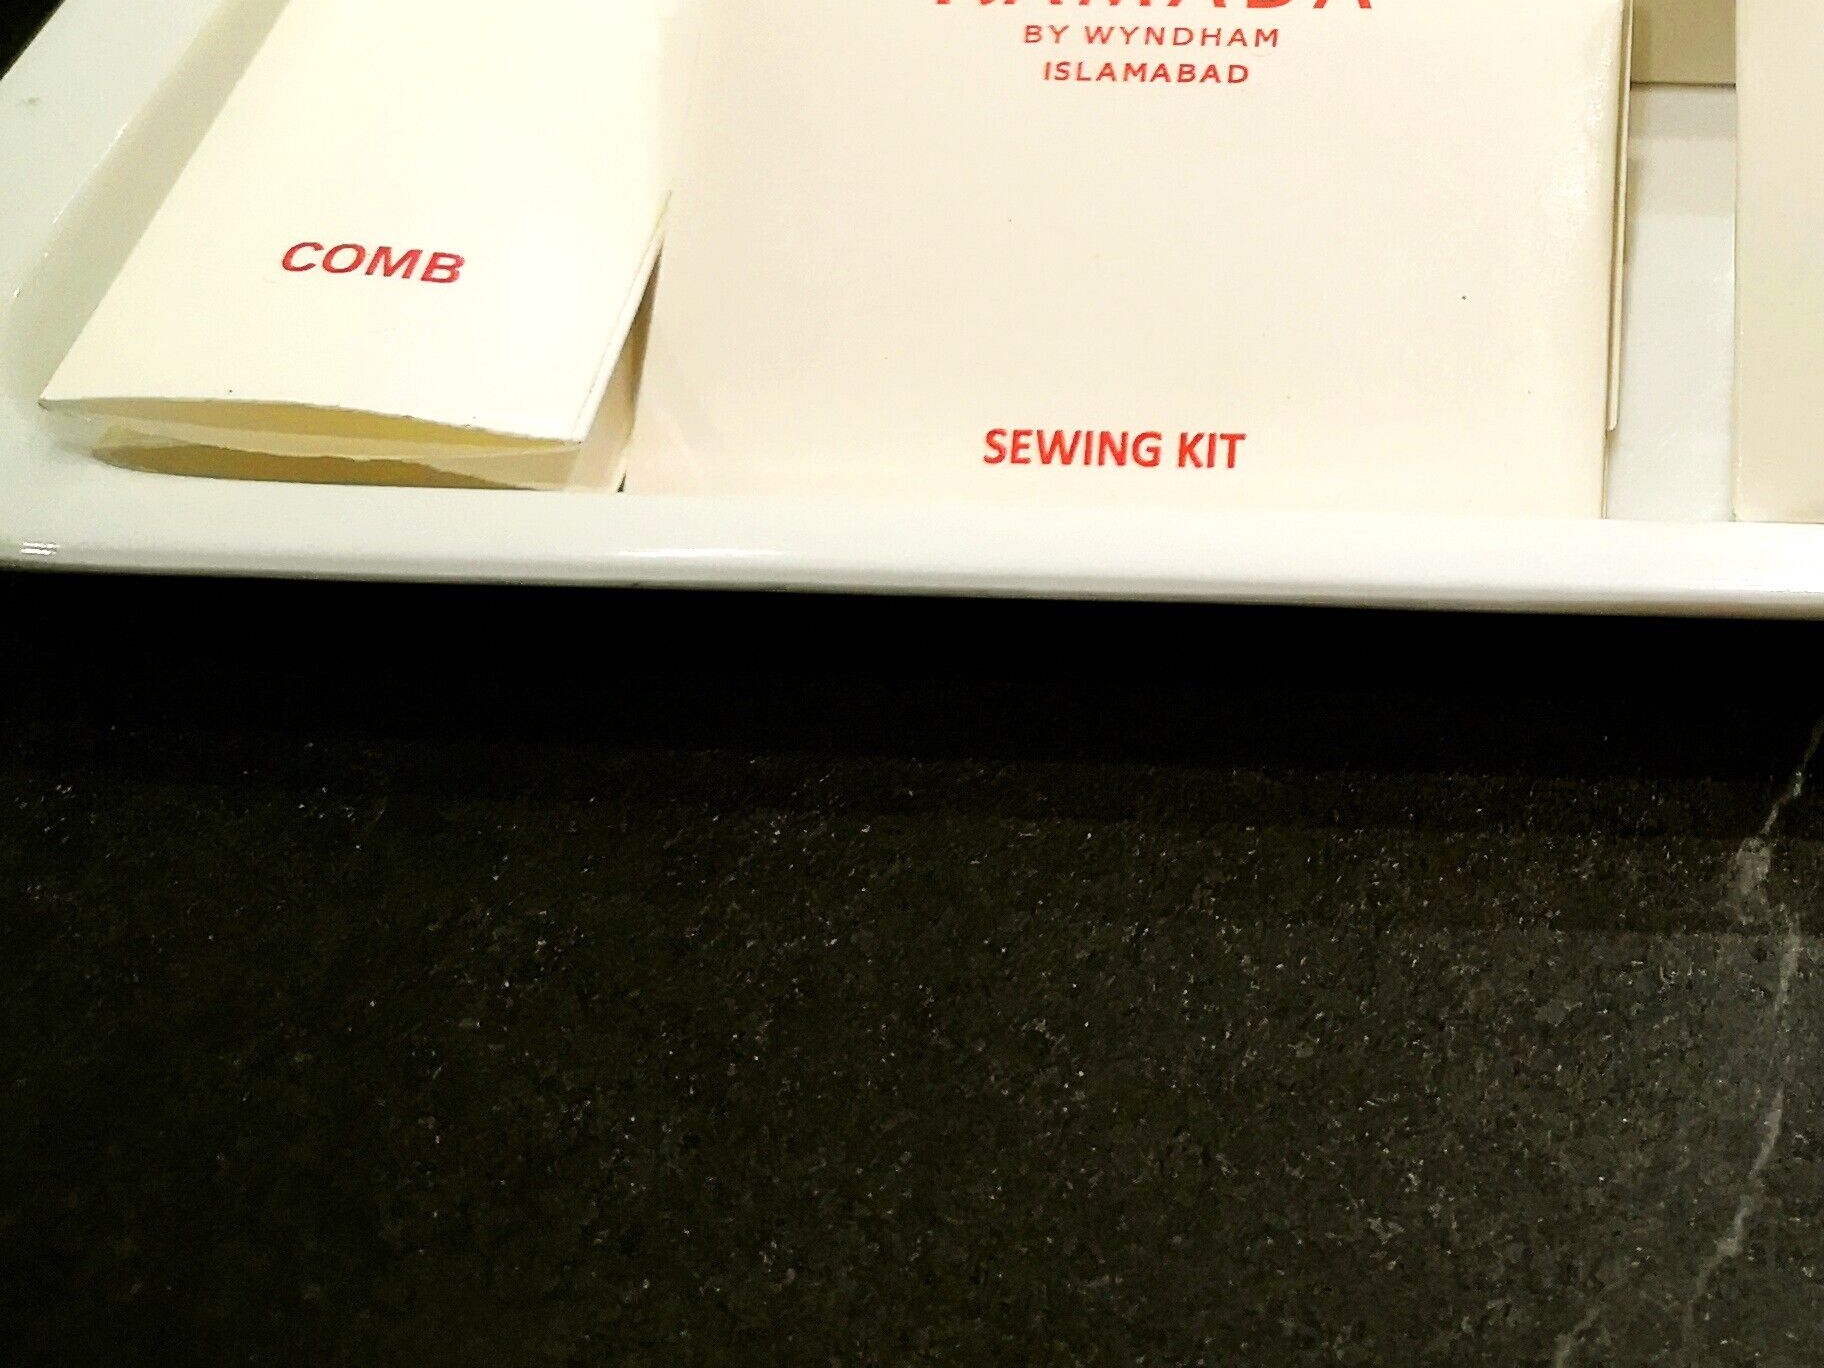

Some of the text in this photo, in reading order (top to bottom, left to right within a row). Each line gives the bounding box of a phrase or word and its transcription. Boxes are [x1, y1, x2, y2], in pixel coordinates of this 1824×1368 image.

[1023, 24, 1280, 48] BY WYNDHAM
[1043, 61, 1250, 85] ISLAMABAD
[281, 241, 465, 284] COMB
[983, 428, 1248, 469] SEWING KIT
